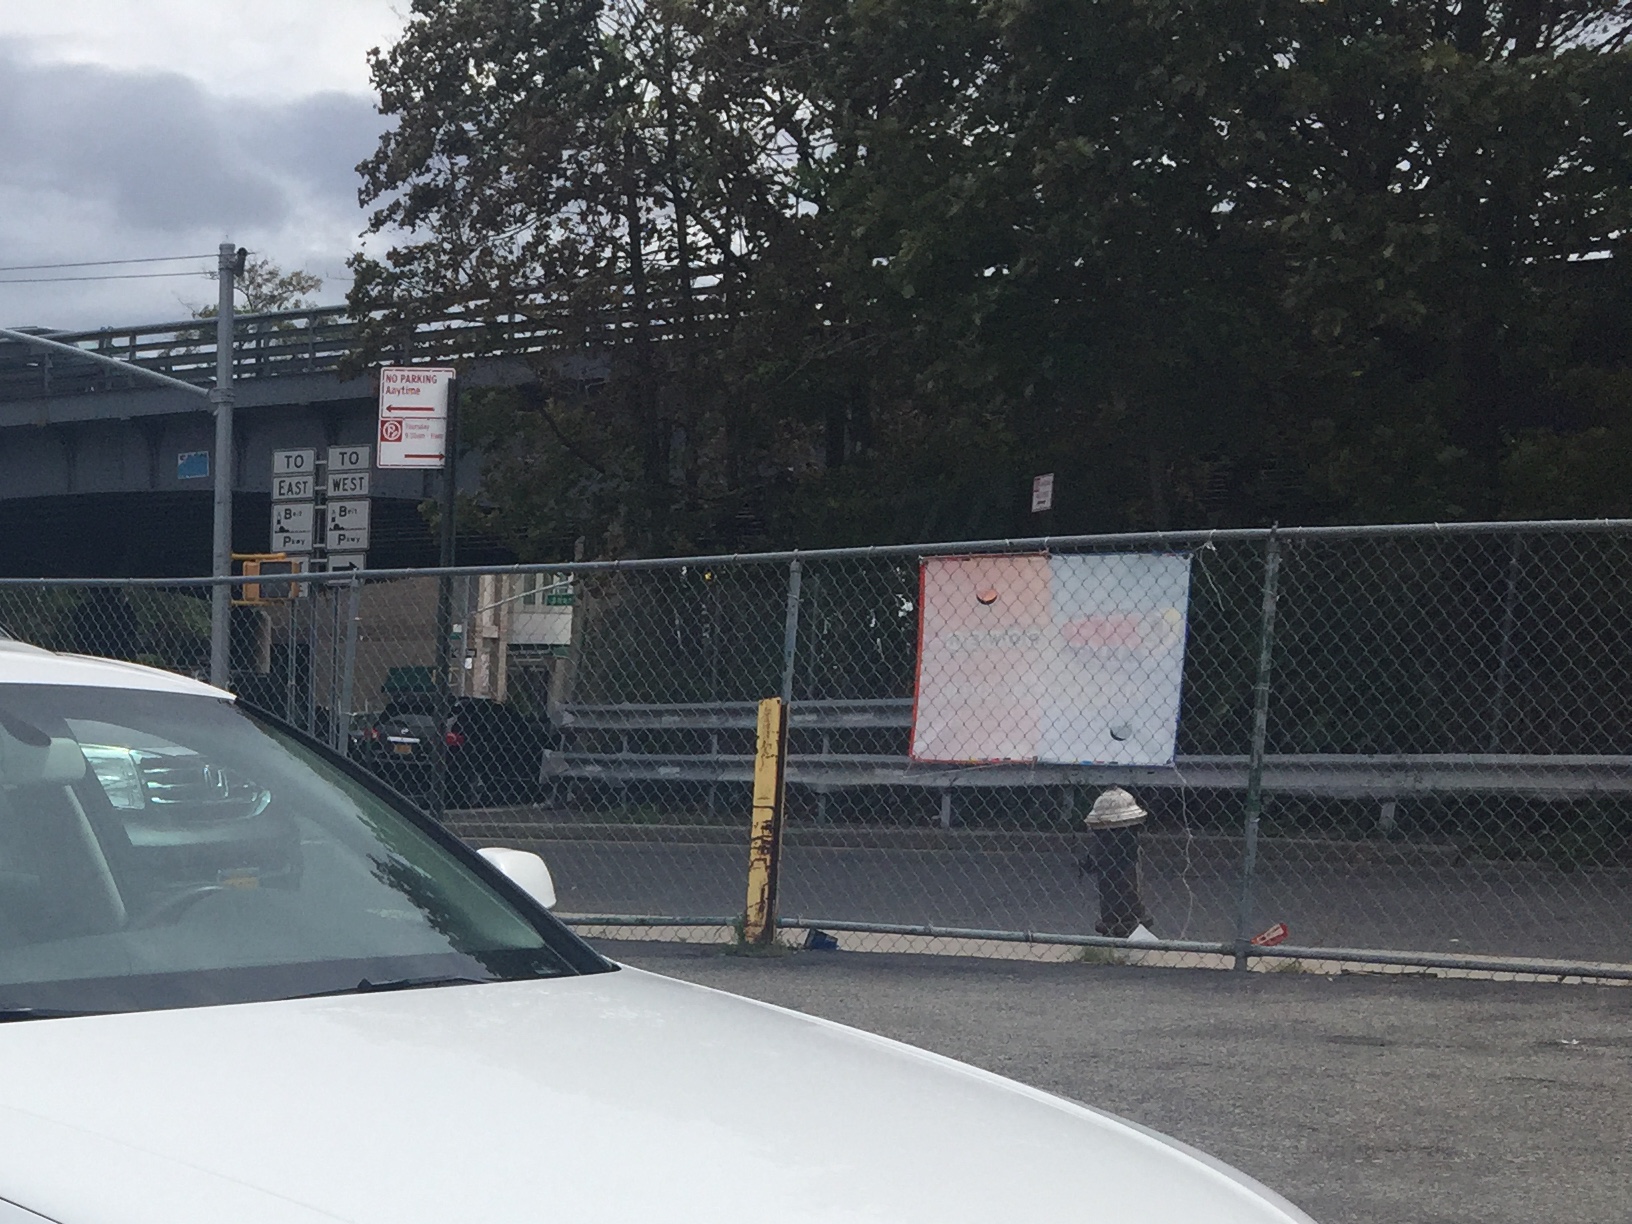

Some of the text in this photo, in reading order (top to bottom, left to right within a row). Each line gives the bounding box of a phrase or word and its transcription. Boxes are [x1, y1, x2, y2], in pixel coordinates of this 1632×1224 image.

[385, 374, 437, 384] NO PARKING
[385, 385, 421, 396] Anytime
[284, 454, 305, 469] TO
[338, 451, 360, 466] TO
[278, 480, 309, 496] EAST
[332, 476, 365, 492] WEST
